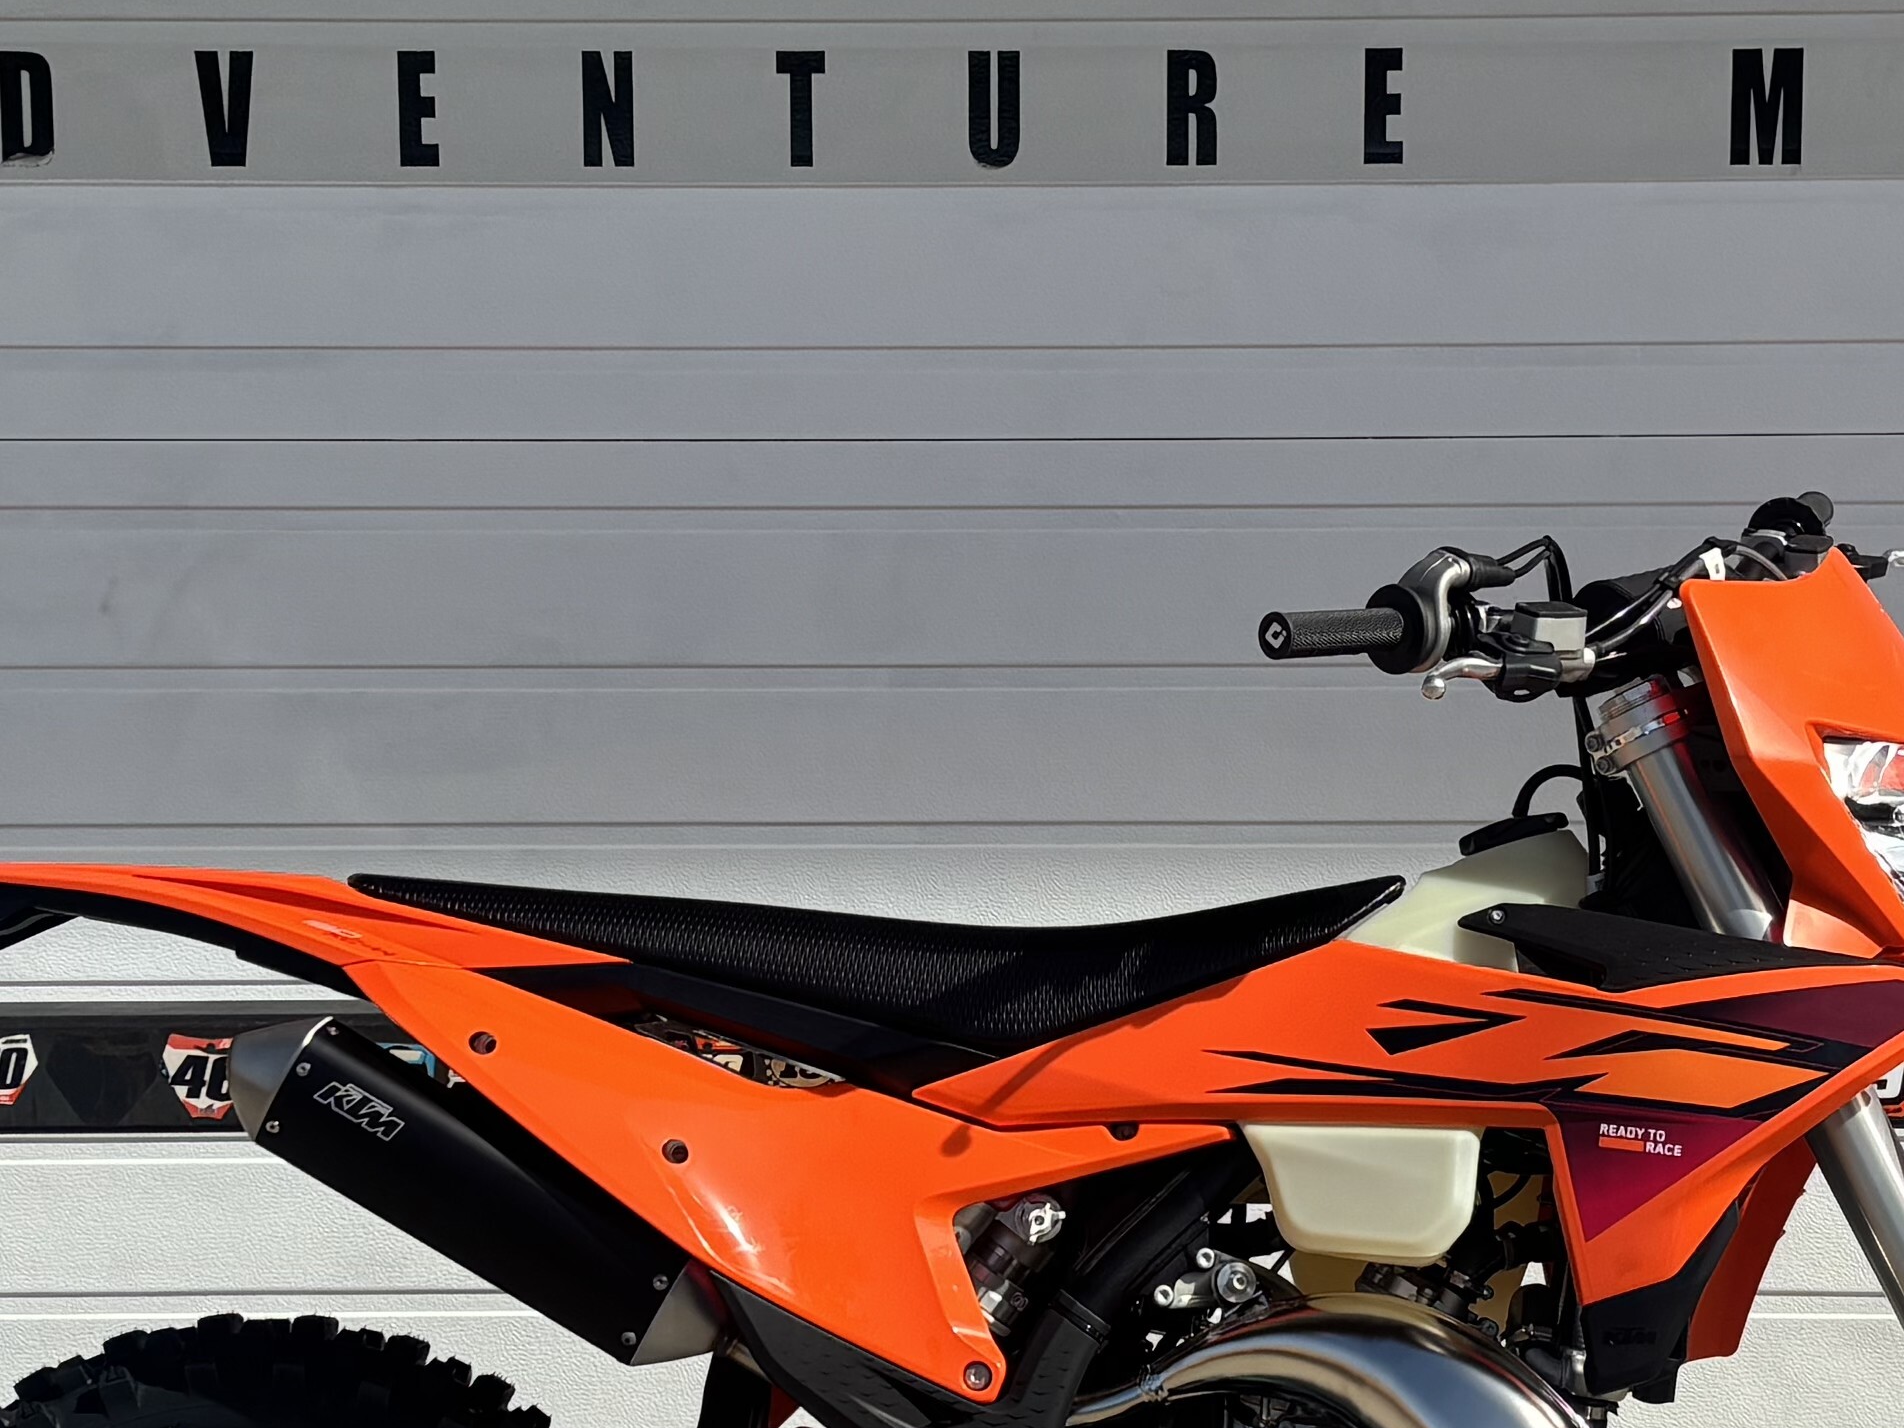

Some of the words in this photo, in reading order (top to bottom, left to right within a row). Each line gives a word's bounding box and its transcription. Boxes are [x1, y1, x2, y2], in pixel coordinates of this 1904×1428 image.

[313, 1081, 405, 1142] KTM
[1599, 1123, 1645, 1139] READY
[1648, 1129, 1666, 1142] TO
[1646, 1142, 1682, 1156] RACE
